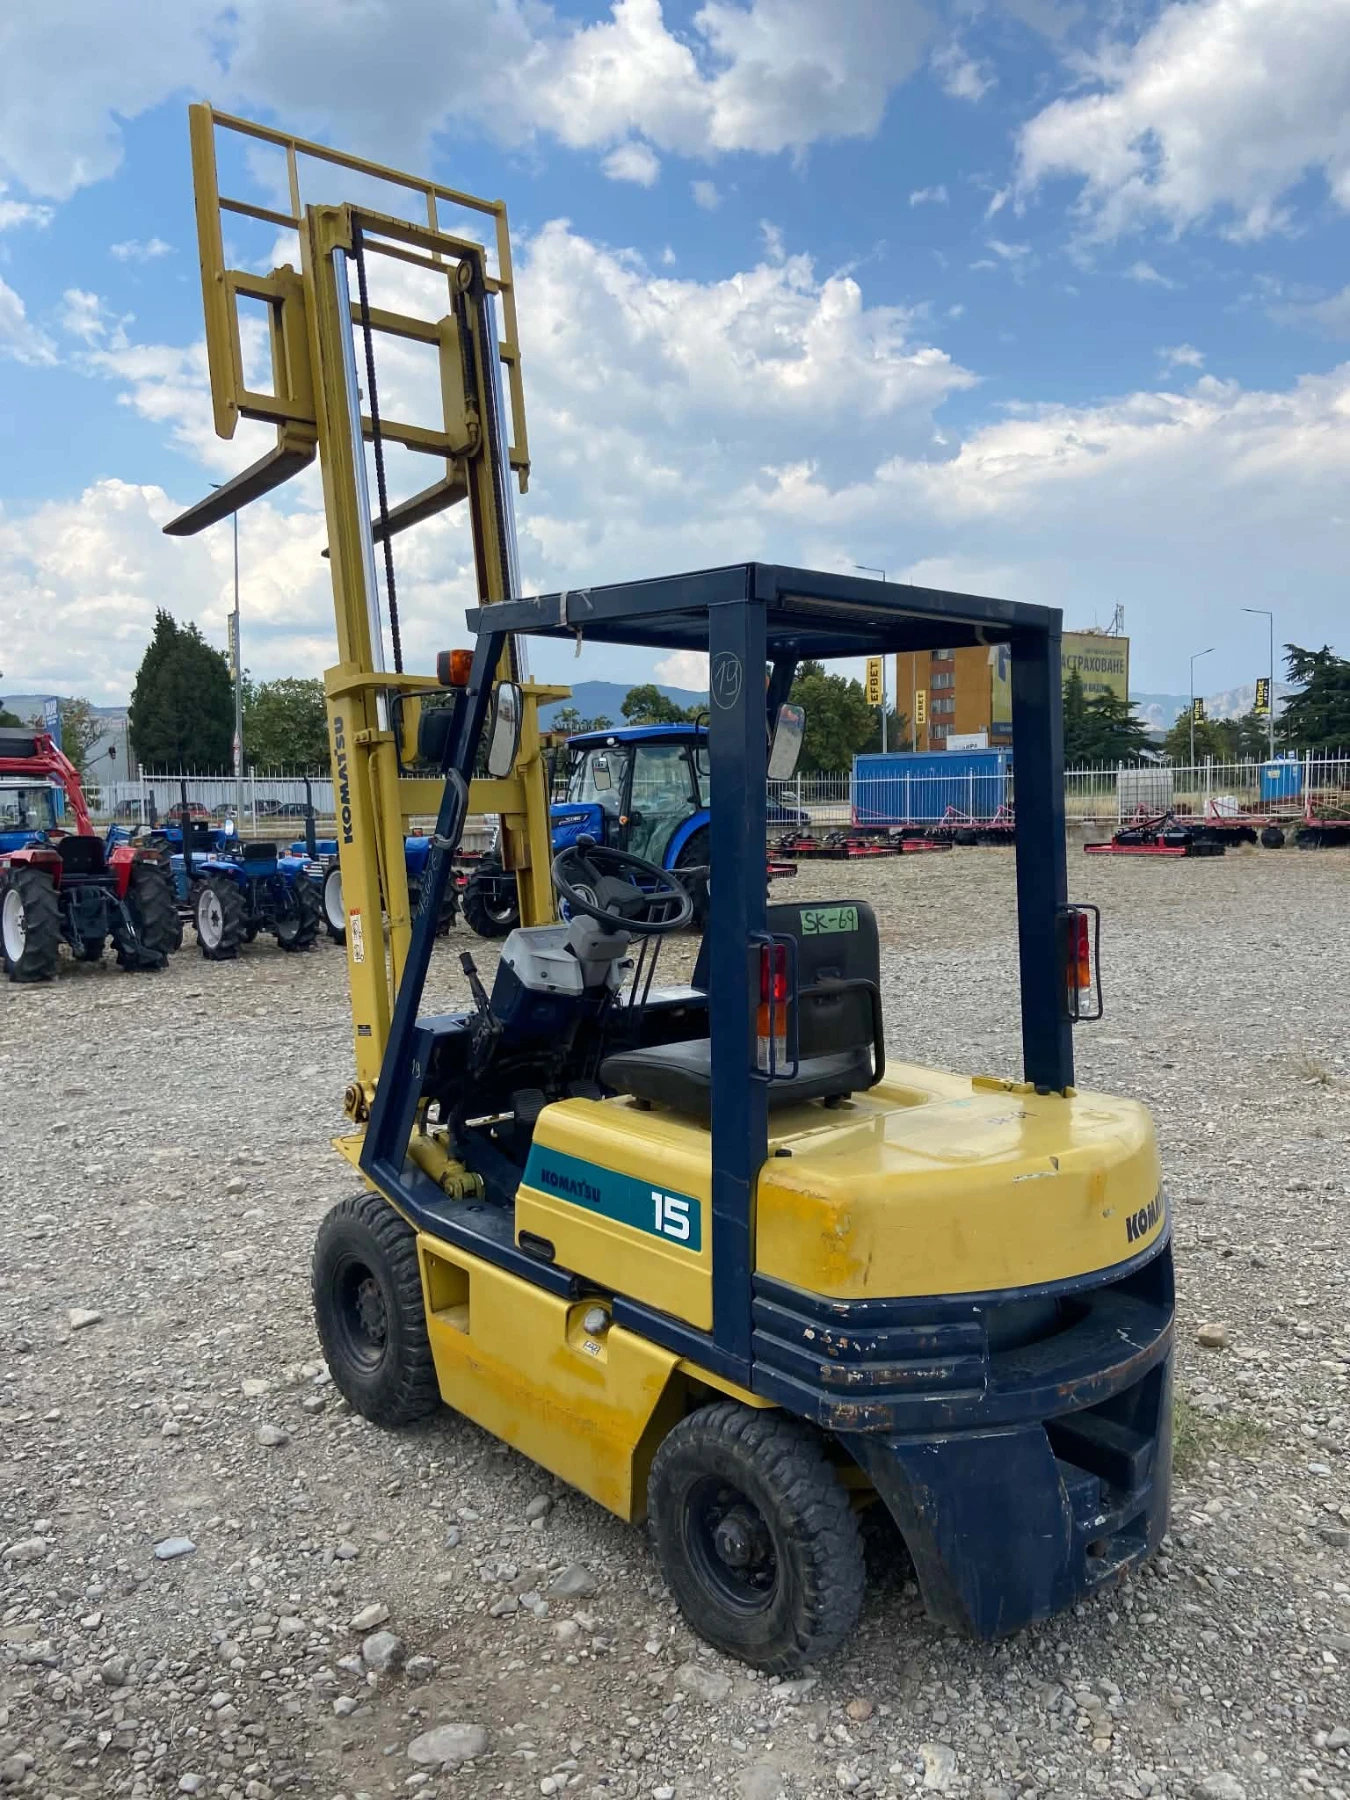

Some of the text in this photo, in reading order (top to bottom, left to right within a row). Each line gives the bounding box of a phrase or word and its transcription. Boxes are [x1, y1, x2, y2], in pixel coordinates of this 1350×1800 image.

[714, 659, 740, 697] 19
[870, 660, 879, 701] EFBET
[334, 716, 353, 844] KOMATSU
[803, 909, 856, 934] SK-69
[541, 1168, 600, 1203] KOMATSU
[652, 1191, 690, 1240] 15
